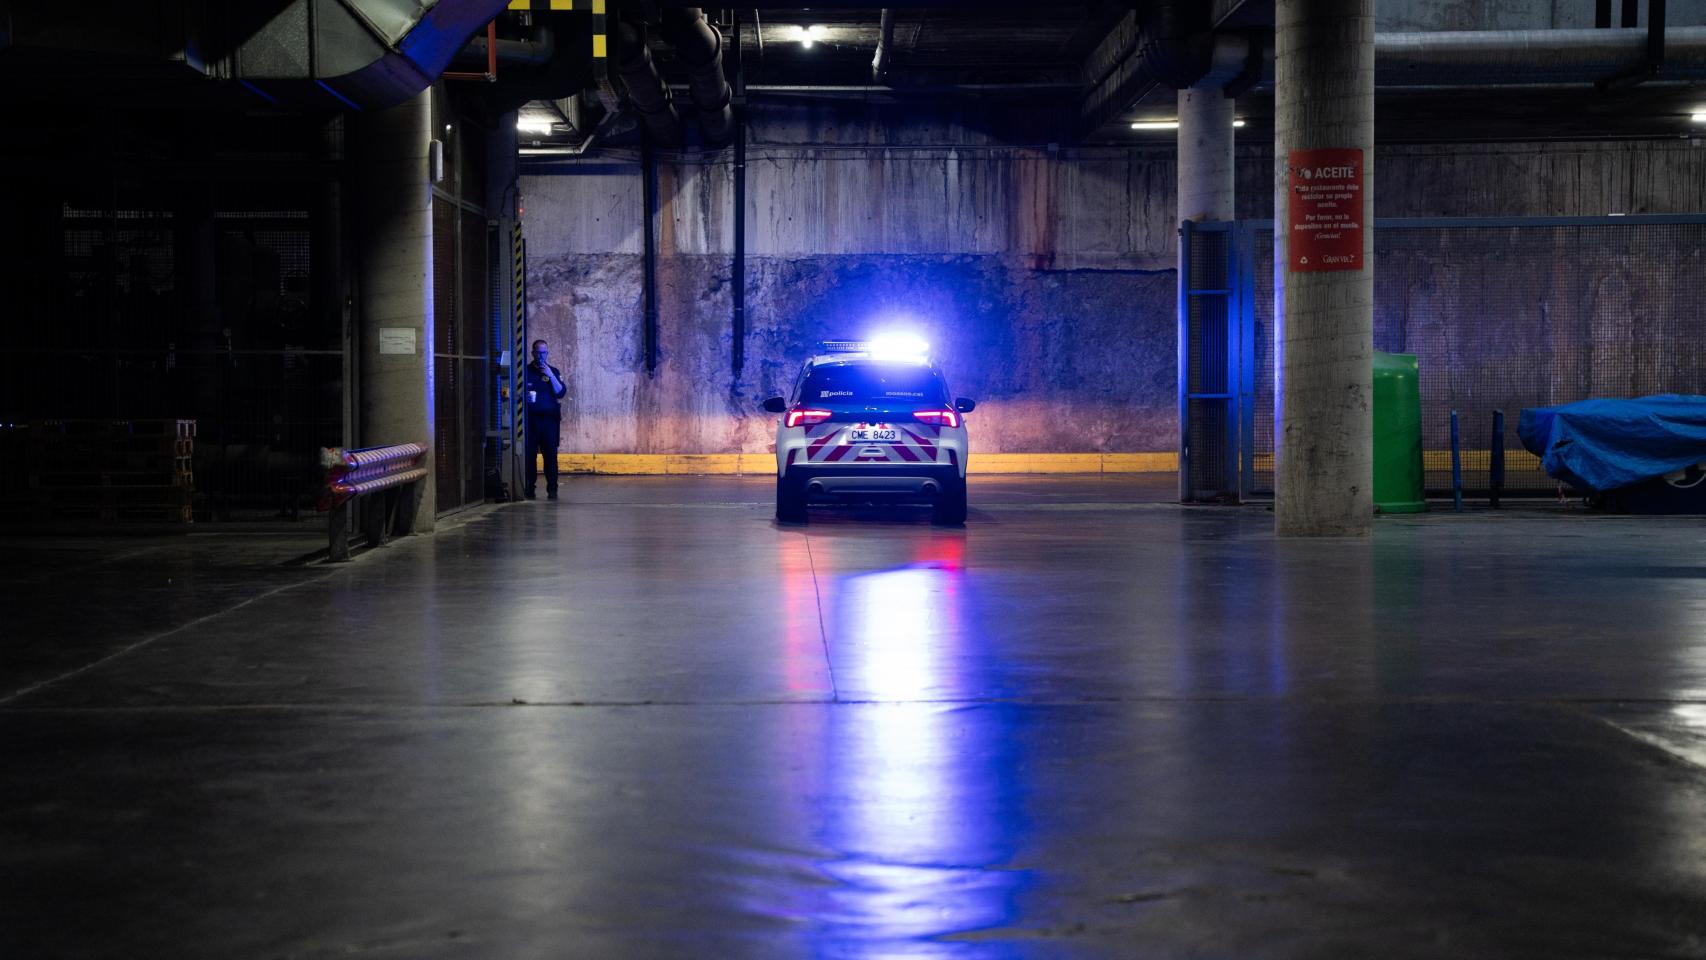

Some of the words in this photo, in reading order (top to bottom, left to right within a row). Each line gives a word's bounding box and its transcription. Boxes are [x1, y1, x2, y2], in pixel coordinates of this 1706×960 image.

[1315, 167, 1355, 178] ACEITE
[851, 430, 869, 440] CME
[872, 430, 896, 440] 8423
